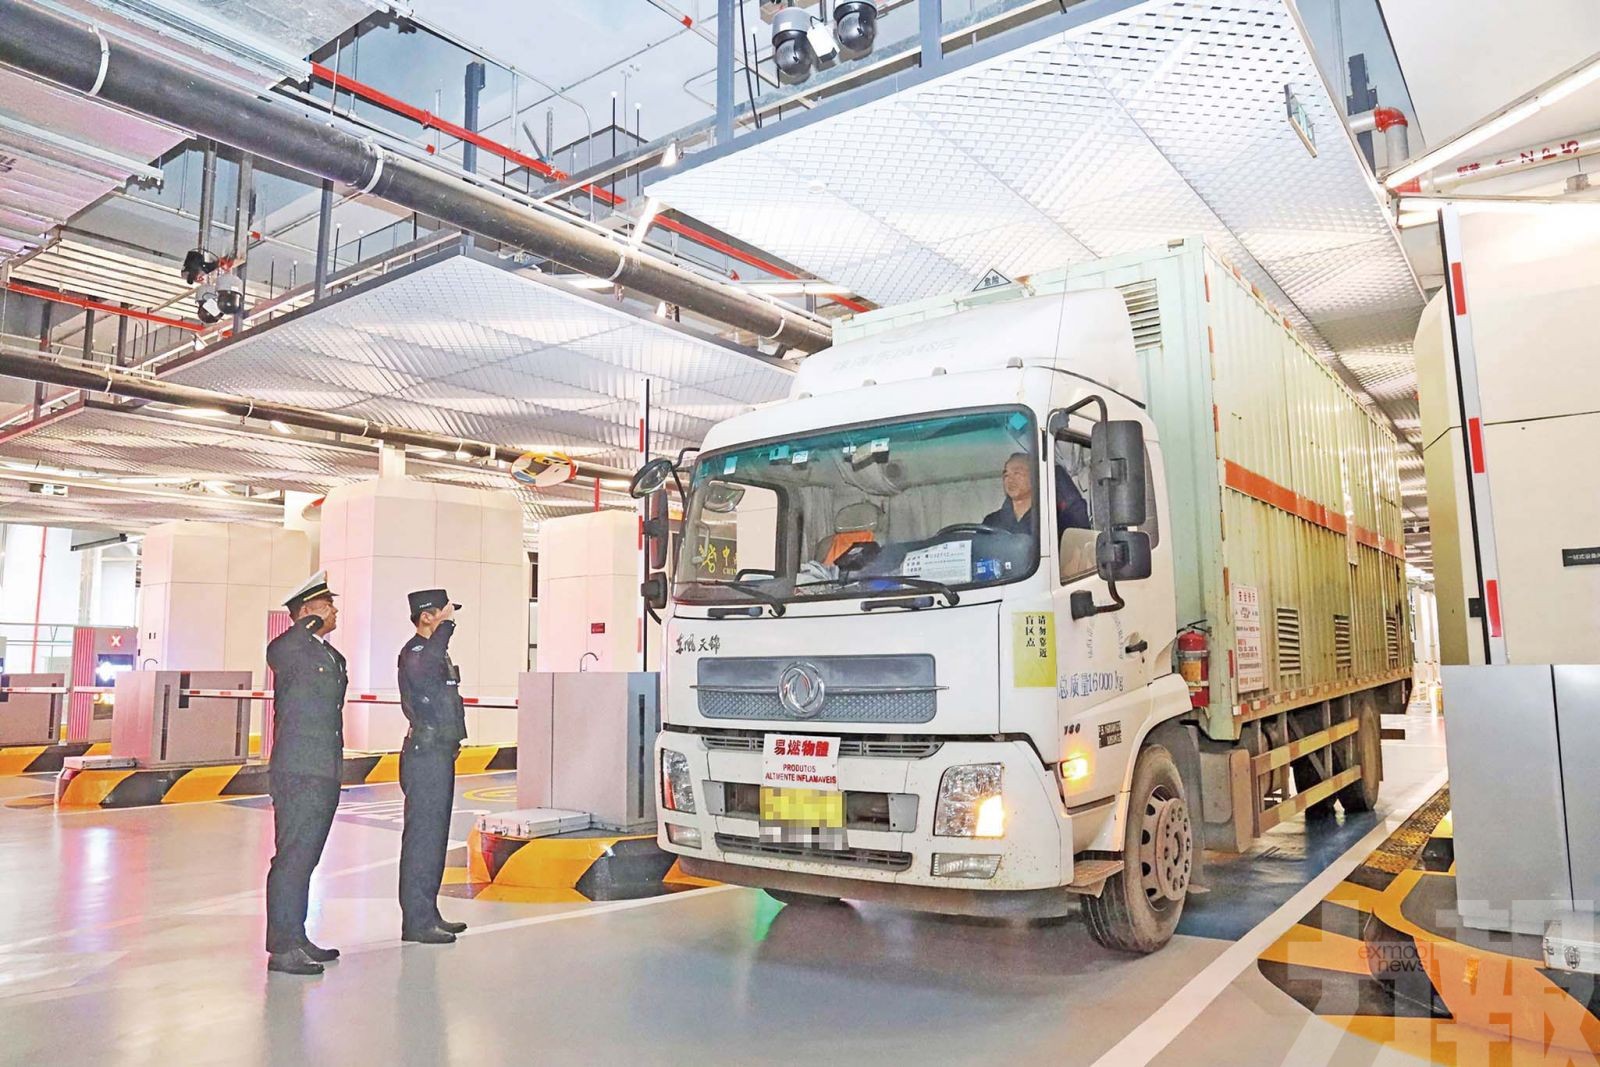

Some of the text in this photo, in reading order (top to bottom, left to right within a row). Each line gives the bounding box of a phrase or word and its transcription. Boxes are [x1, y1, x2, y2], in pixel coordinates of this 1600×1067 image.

[1038, 615, 1048, 658] 请勿靠近
[774, 739, 830, 757] 易燃物體
[782, 764, 817, 773] PRODUTOS
